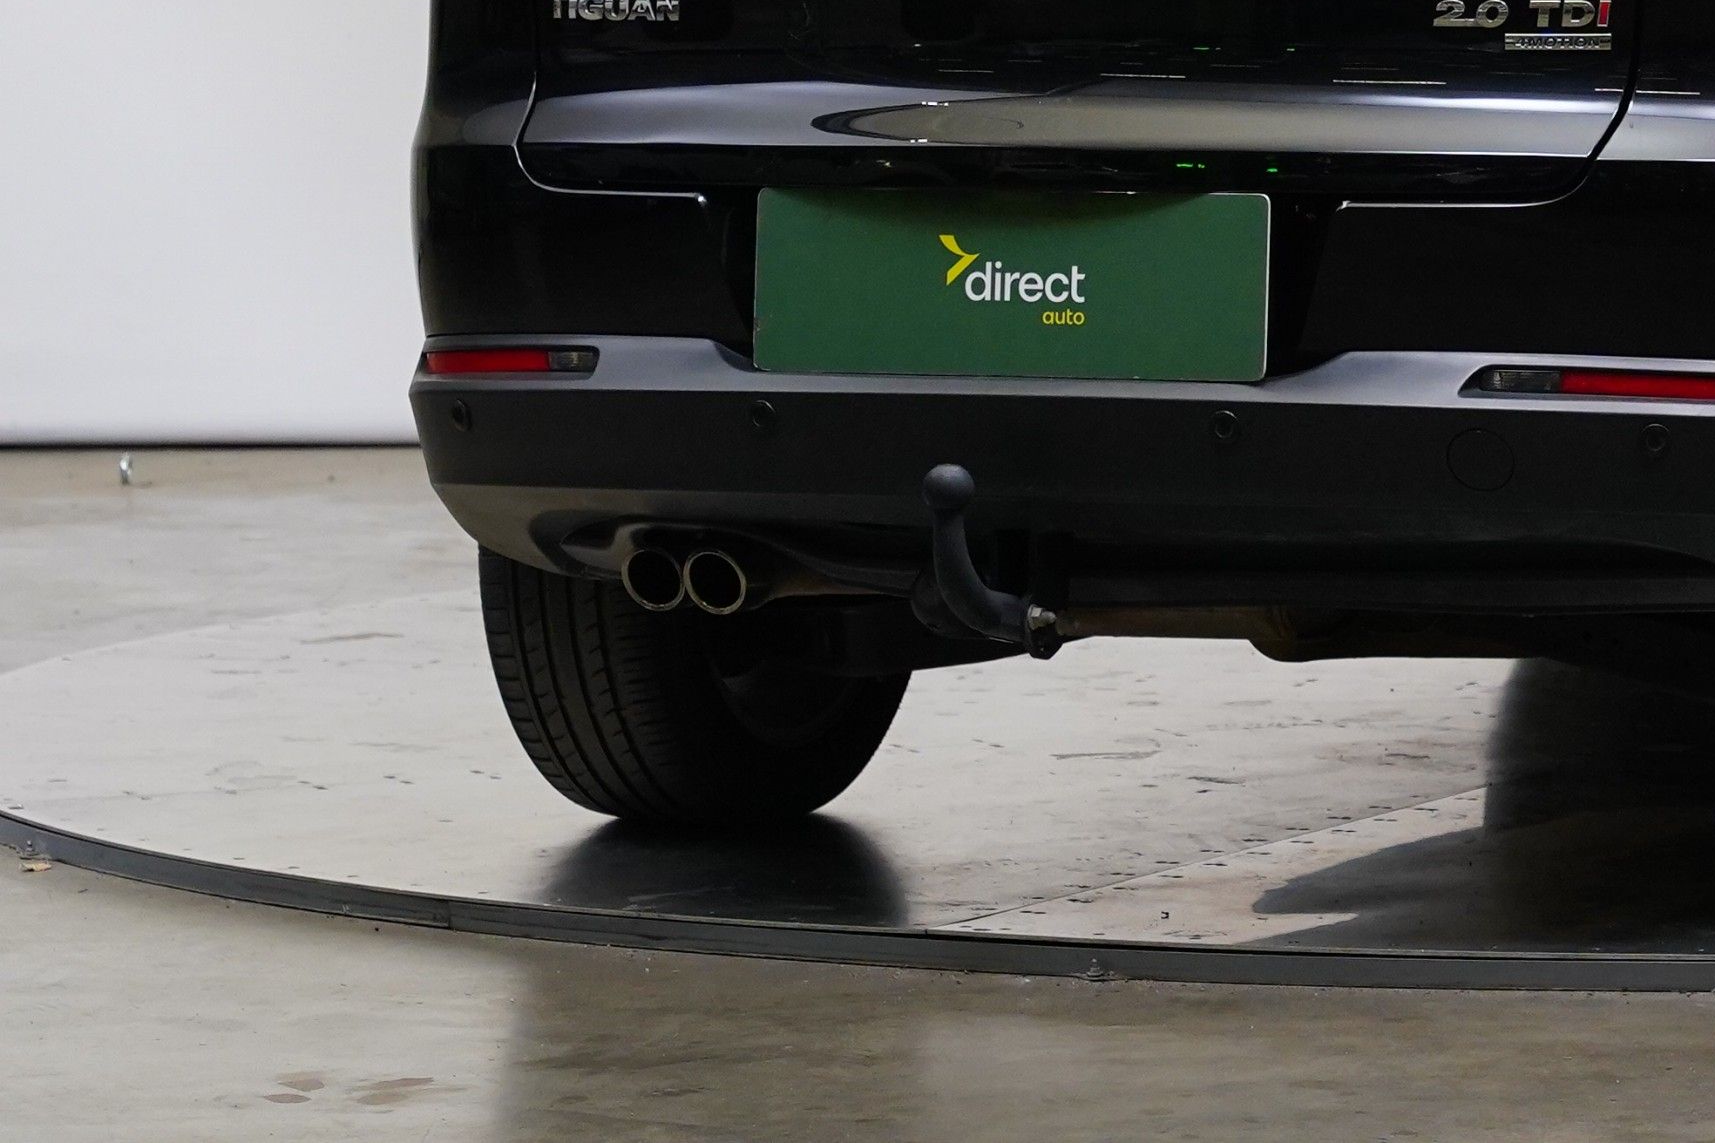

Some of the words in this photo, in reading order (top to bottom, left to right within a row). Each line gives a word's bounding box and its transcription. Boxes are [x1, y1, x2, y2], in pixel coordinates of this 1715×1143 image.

[1529, 0, 1612, 27] TDI
[965, 261, 1086, 304] direct
[1042, 308, 1085, 325] auto
